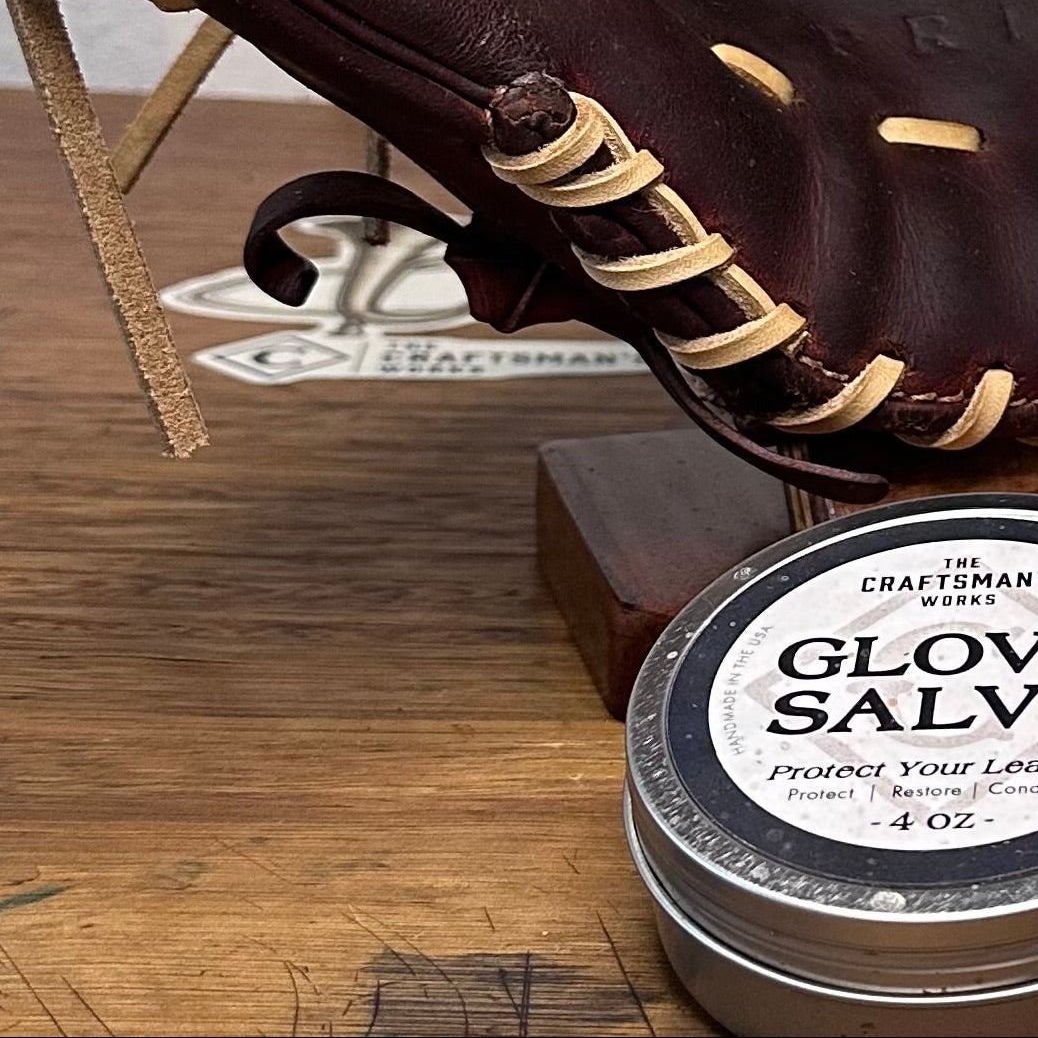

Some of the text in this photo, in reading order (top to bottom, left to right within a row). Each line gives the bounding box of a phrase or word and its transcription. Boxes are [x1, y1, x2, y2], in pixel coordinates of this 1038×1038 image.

[944, 557, 981, 569] THE
[921, 594, 996, 607] WORKS
[724, 625, 774, 756] HANDMADE IN THE USA
[766, 761, 886, 781] Protect
[899, 760, 974, 779] Your
[788, 786, 854, 801] Protect
[892, 784, 961, 799] Restore
